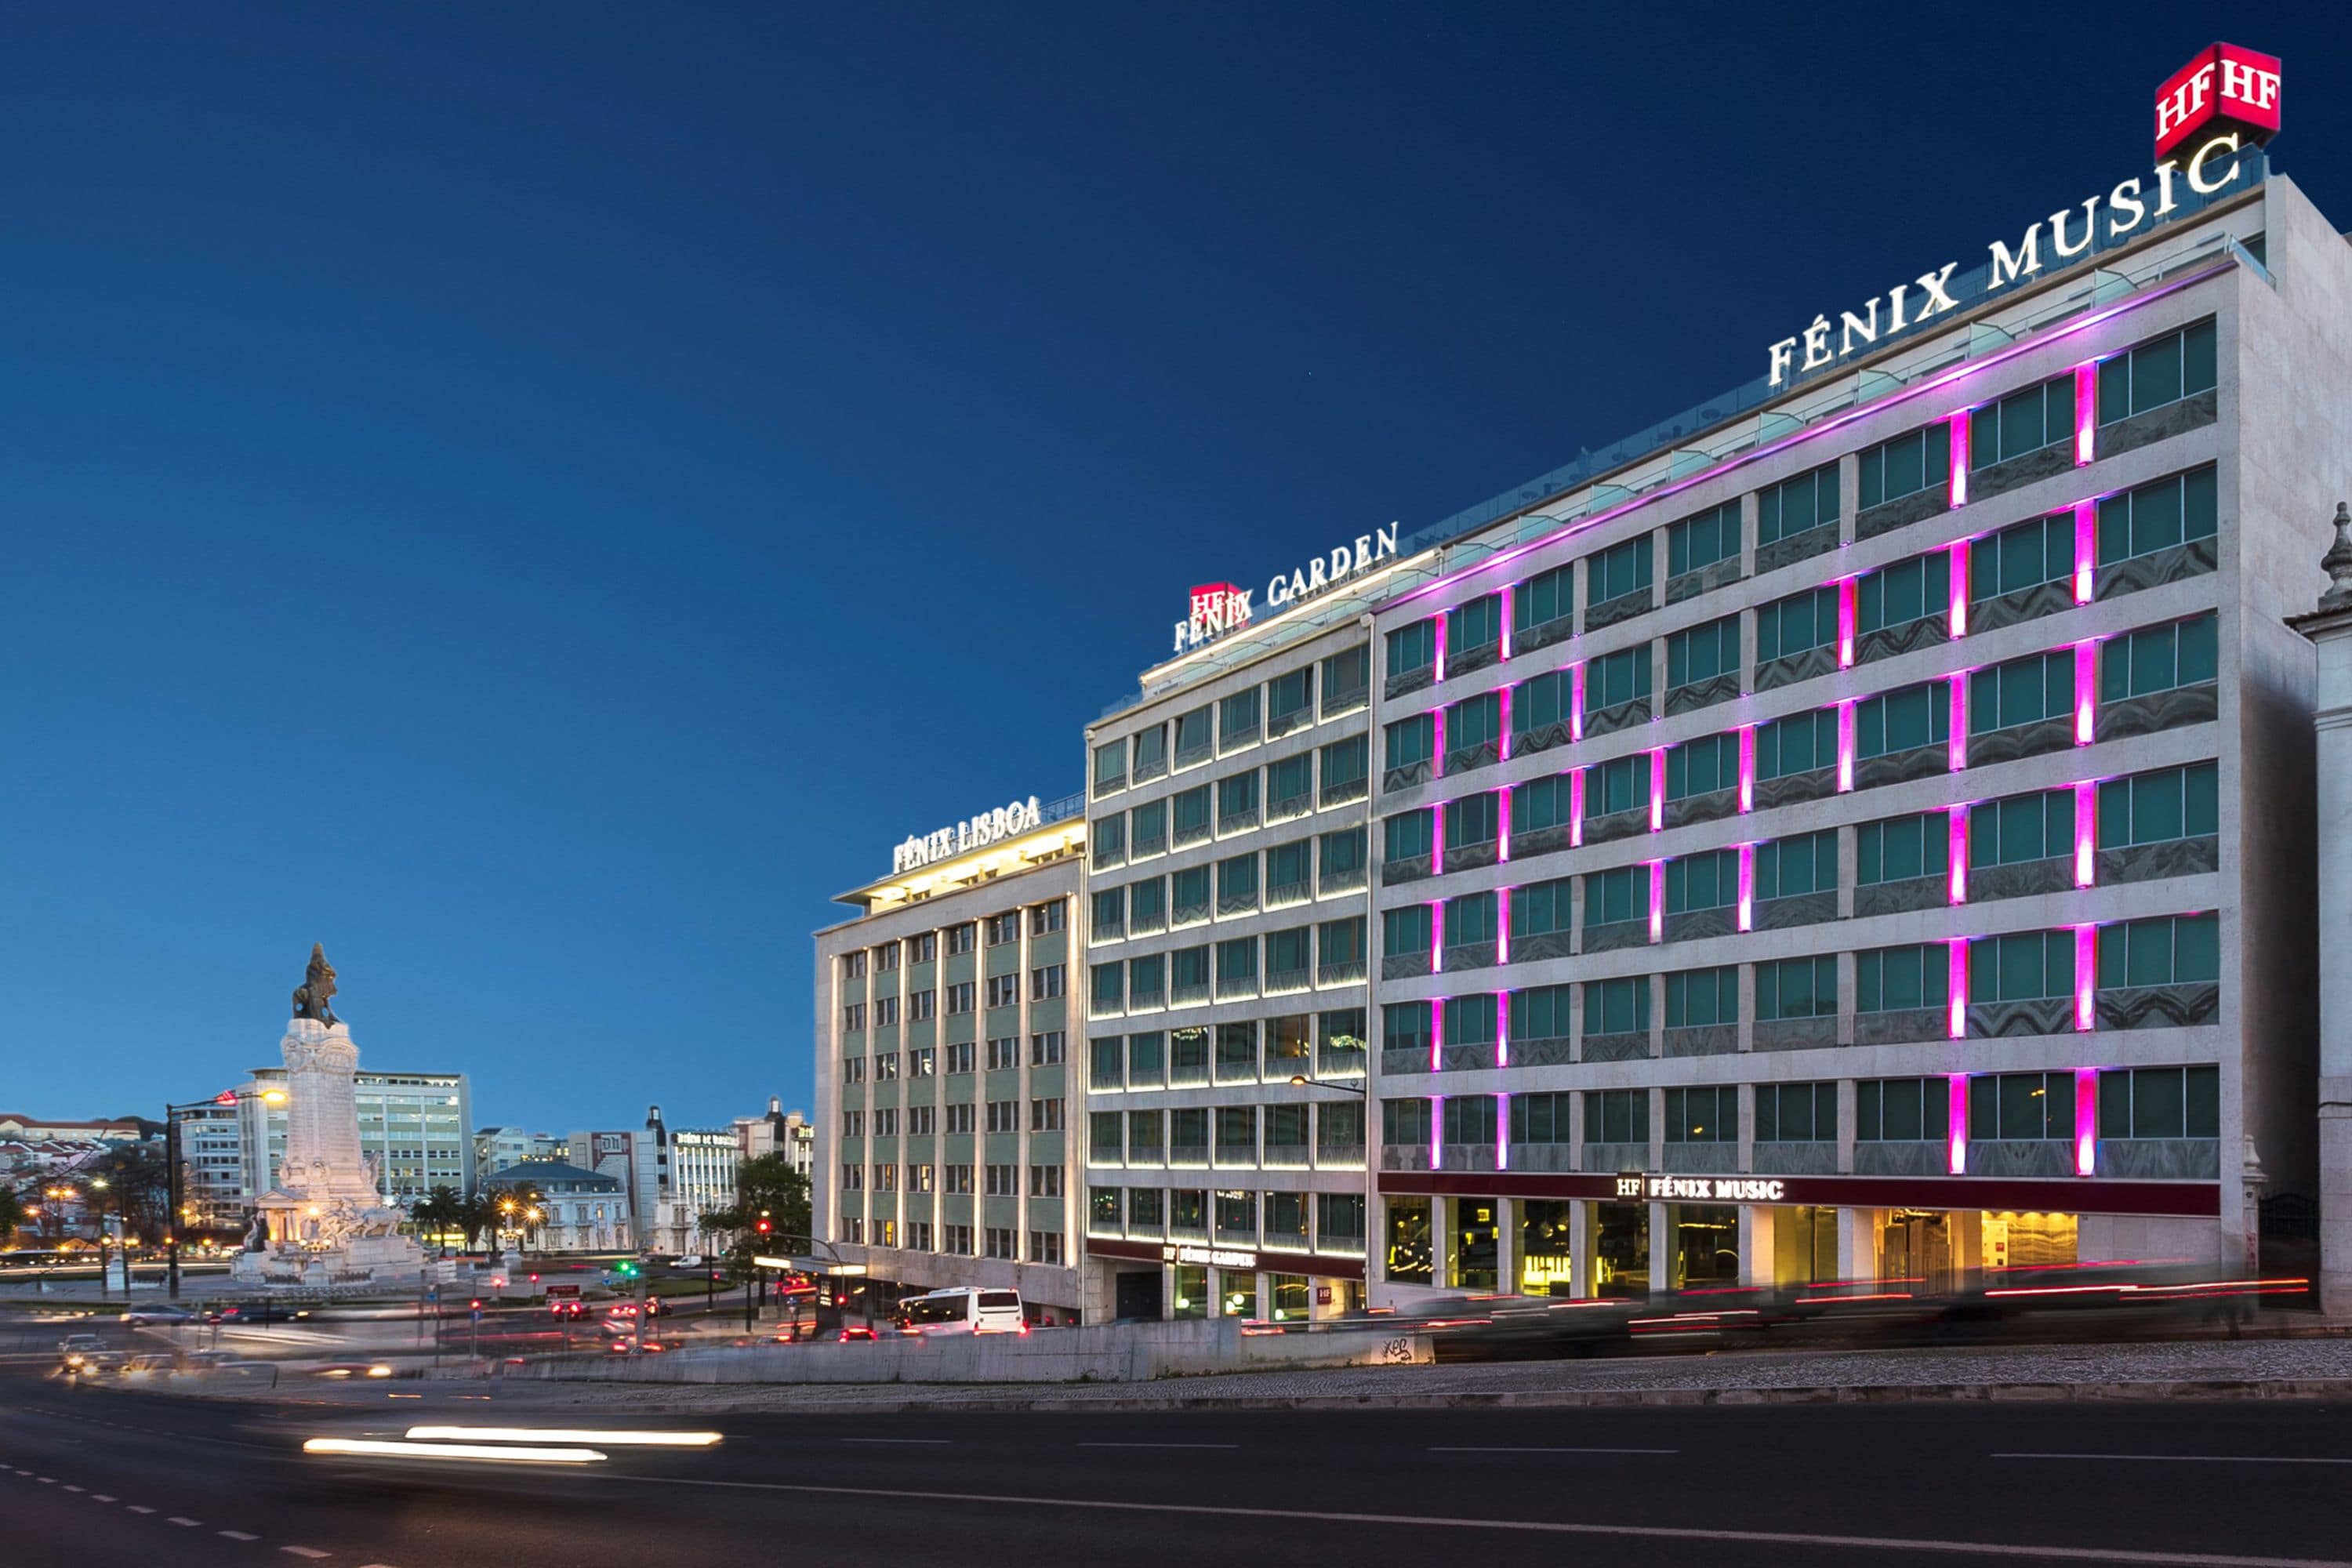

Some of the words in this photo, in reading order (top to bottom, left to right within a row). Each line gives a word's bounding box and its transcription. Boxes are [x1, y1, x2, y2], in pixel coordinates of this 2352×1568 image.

[2156, 62, 2215, 140] HF
[2220, 59, 2281, 110] HF
[1768, 261, 1958, 387] FÉNIX
[1987, 132, 2239, 289] MUSIC
[1268, 521, 1399, 606] GARDEN
[894, 826, 954, 874] FÉNIX
[958, 796, 1041, 852] LISBOA
[1617, 1178, 1640, 1196] HF
[1649, 1175, 1711, 1199] FÉNIX
[1715, 1180, 1784, 1200] MUSIC
